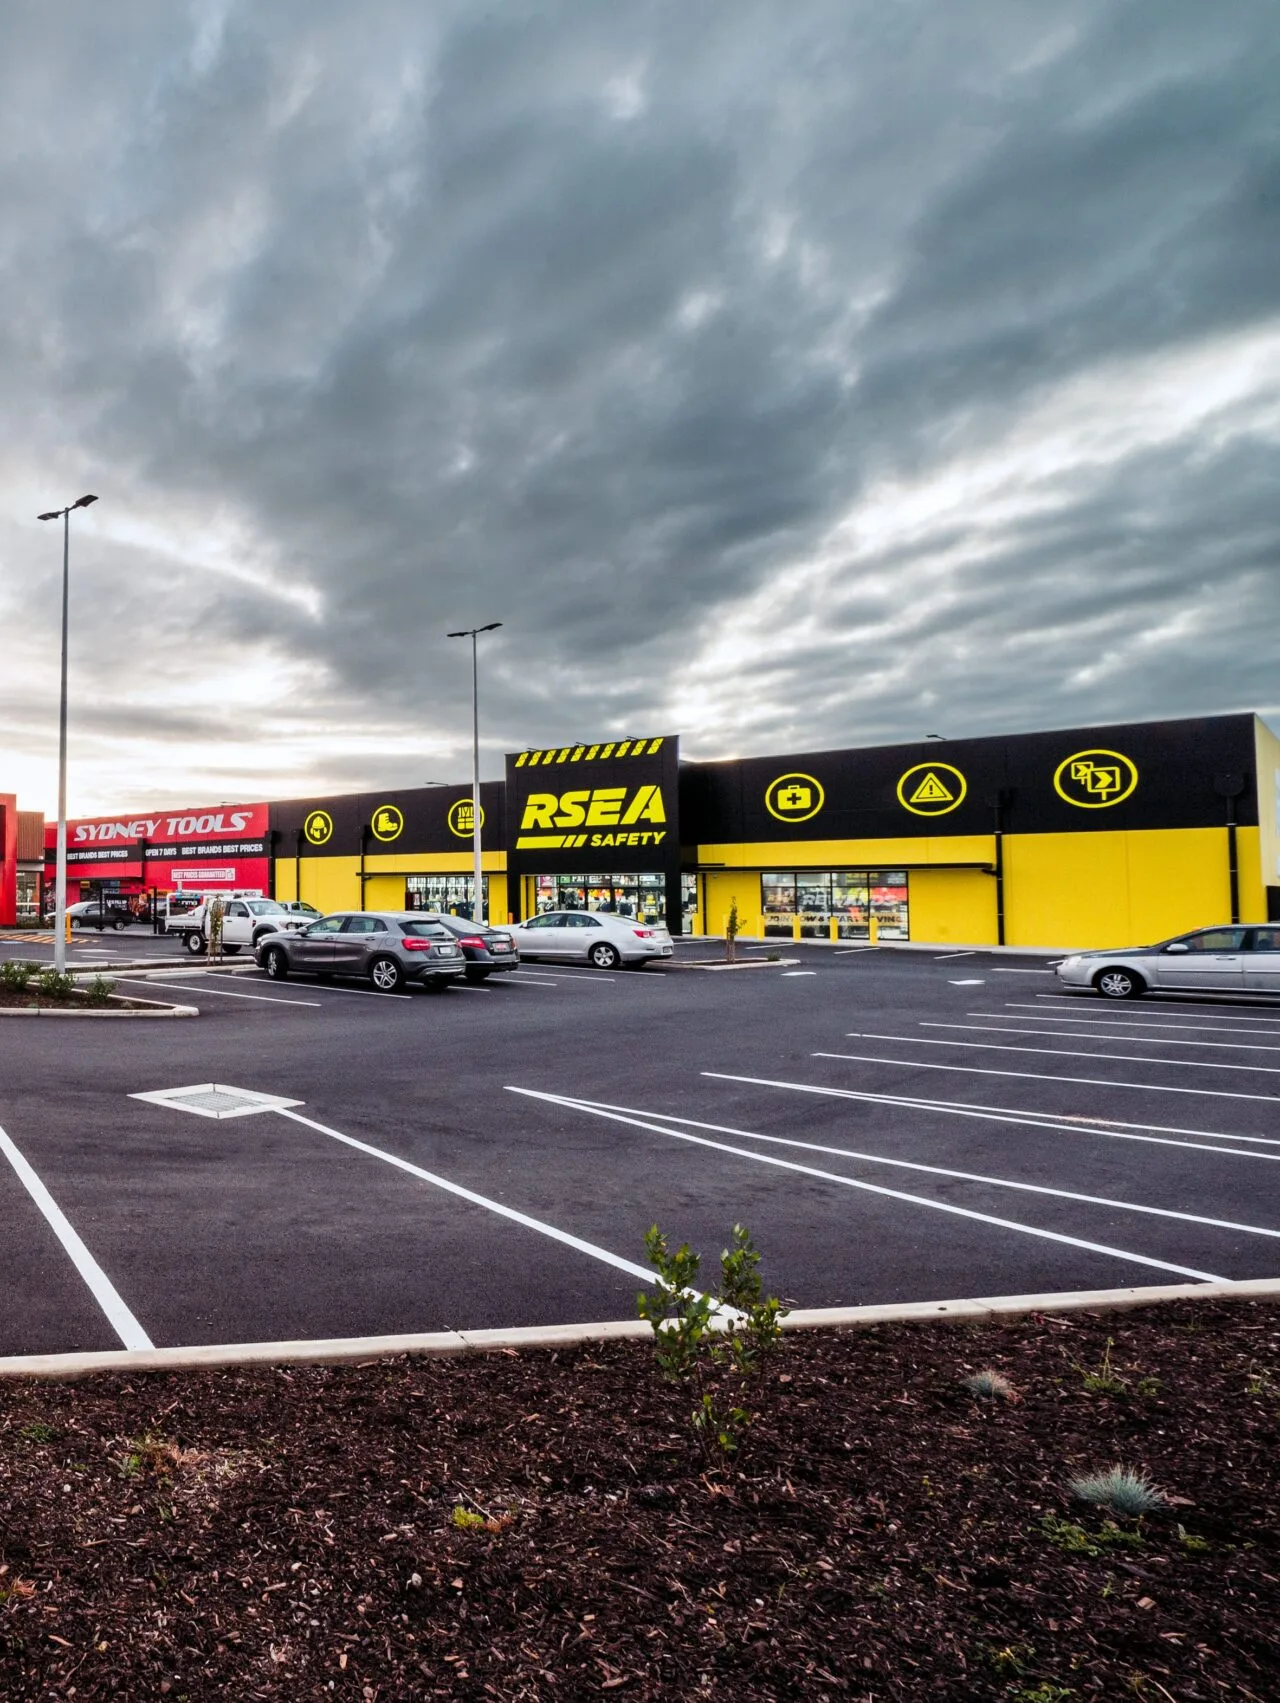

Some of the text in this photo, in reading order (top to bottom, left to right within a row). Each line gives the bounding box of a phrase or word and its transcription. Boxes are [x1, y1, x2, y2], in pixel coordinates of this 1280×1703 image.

[520, 785, 667, 830] RSEA
[73, 819, 162, 842] SYDNEY
[590, 831, 667, 847] SAFETY
[98, 851, 110, 859] BEST
[111, 850, 128, 858] PRICES
[145, 847, 177, 857] OPEN 7 DAYS
[181, 843, 264, 855] BEST BRANDS BEST PRICES
[863, 915, 903, 923] SVING
